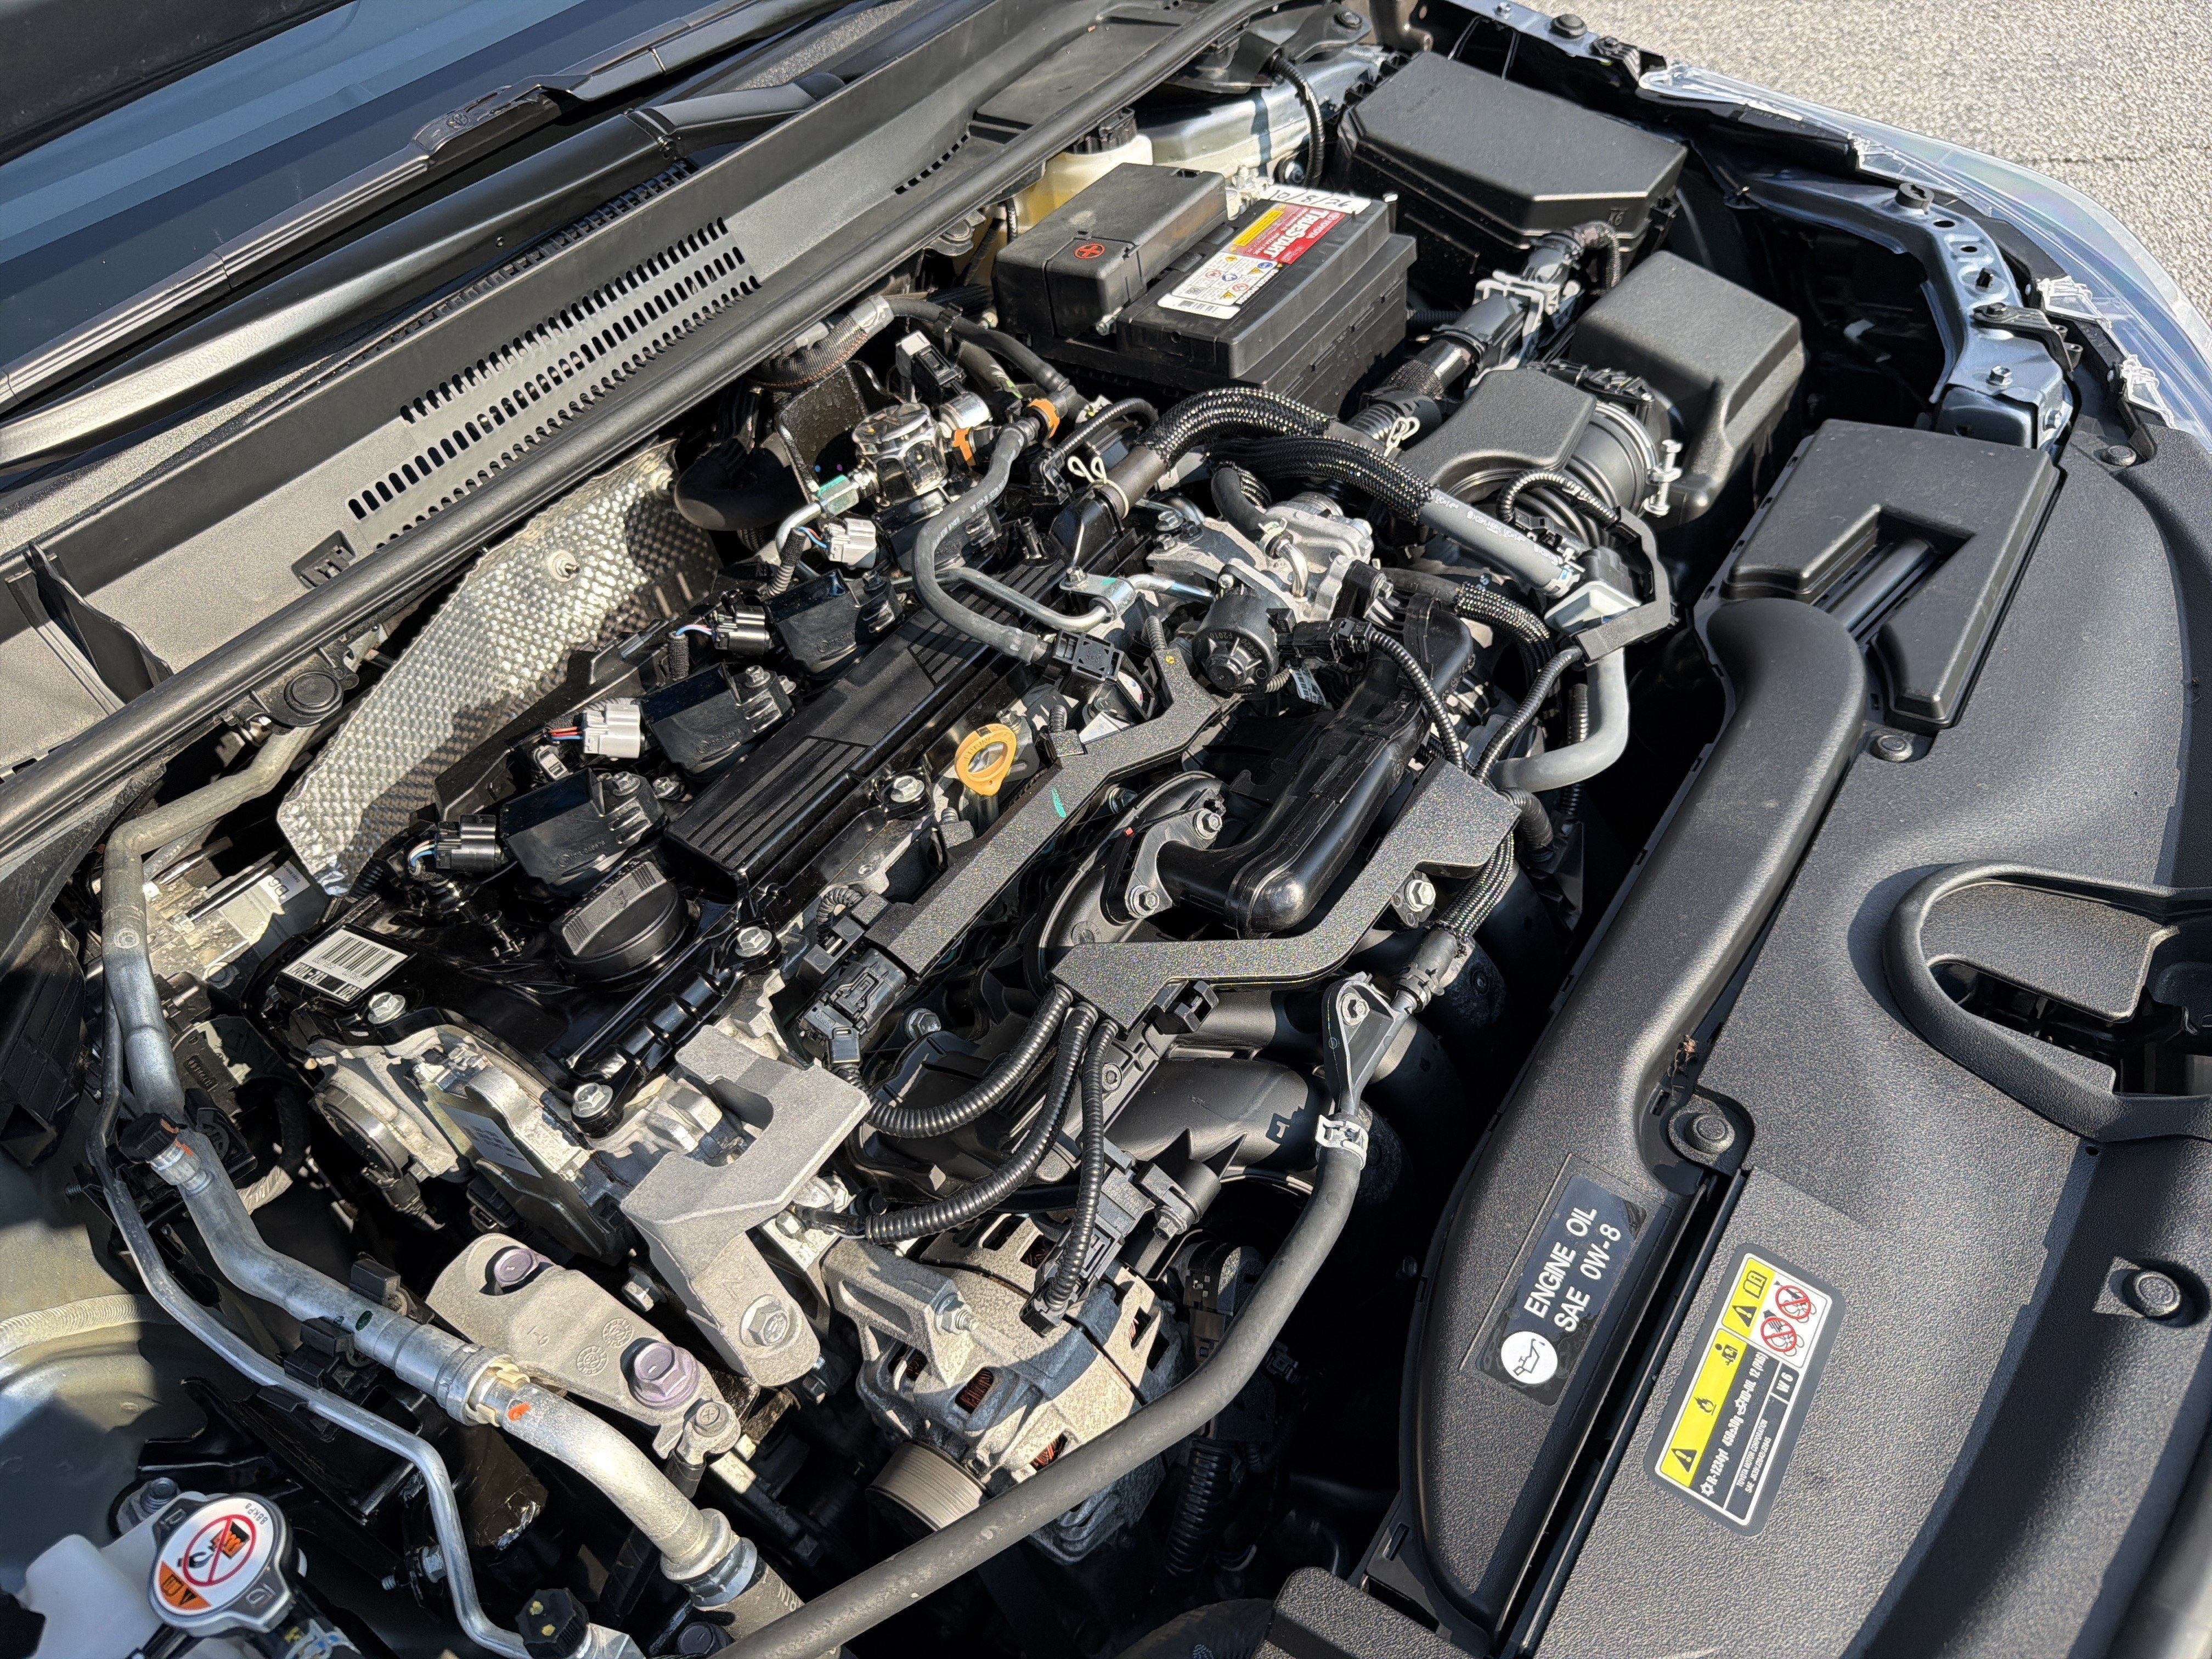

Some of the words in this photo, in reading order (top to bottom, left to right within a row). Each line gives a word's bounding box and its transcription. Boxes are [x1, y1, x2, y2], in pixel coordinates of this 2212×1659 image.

[1305, 218, 1334, 239] TOYOTA
[1241, 639, 1262, 657] 25620
[267, 877, 289, 897] D6
[1523, 1242, 1576, 1319] ENGINE
[1566, 1207, 1597, 1237] OIL
[1554, 1286, 1590, 1332] SAE
[1580, 1224, 1621, 1280] 0W-8
[1753, 1351, 1769, 1372] (PAG)
[1749, 1368, 1761, 1379] 12
[1781, 1372, 1793, 1382] 6
[1776, 1380, 1790, 1393] W
[1722, 1415, 1744, 1447] 450±30g
[1736, 1468, 1749, 1487] TOYOTA
[1743, 1451, 1756, 1469] MOTOR
[1750, 1418, 1768, 1452] CORPORATION
[1706, 1448, 1730, 1486] R-1234yf
[1743, 1480, 1755, 1494] SAE
